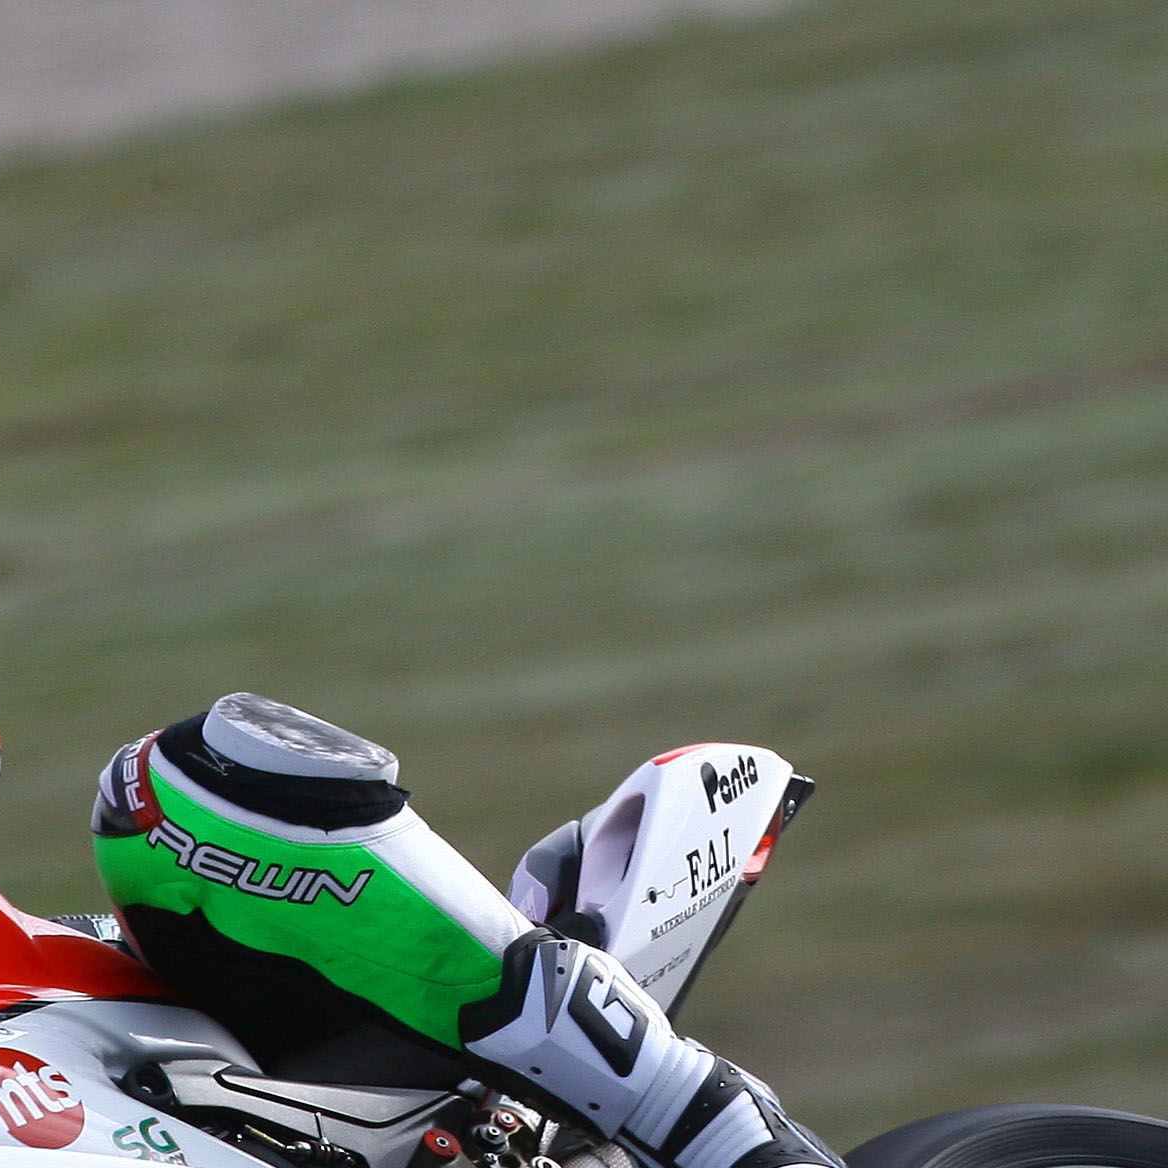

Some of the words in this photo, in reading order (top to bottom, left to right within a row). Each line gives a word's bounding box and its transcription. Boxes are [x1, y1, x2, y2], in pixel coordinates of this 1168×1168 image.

[146, 818, 375, 906] REWIN
[685, 827, 736, 898] F.A.I.
[113, 1117, 181, 1160] SG
